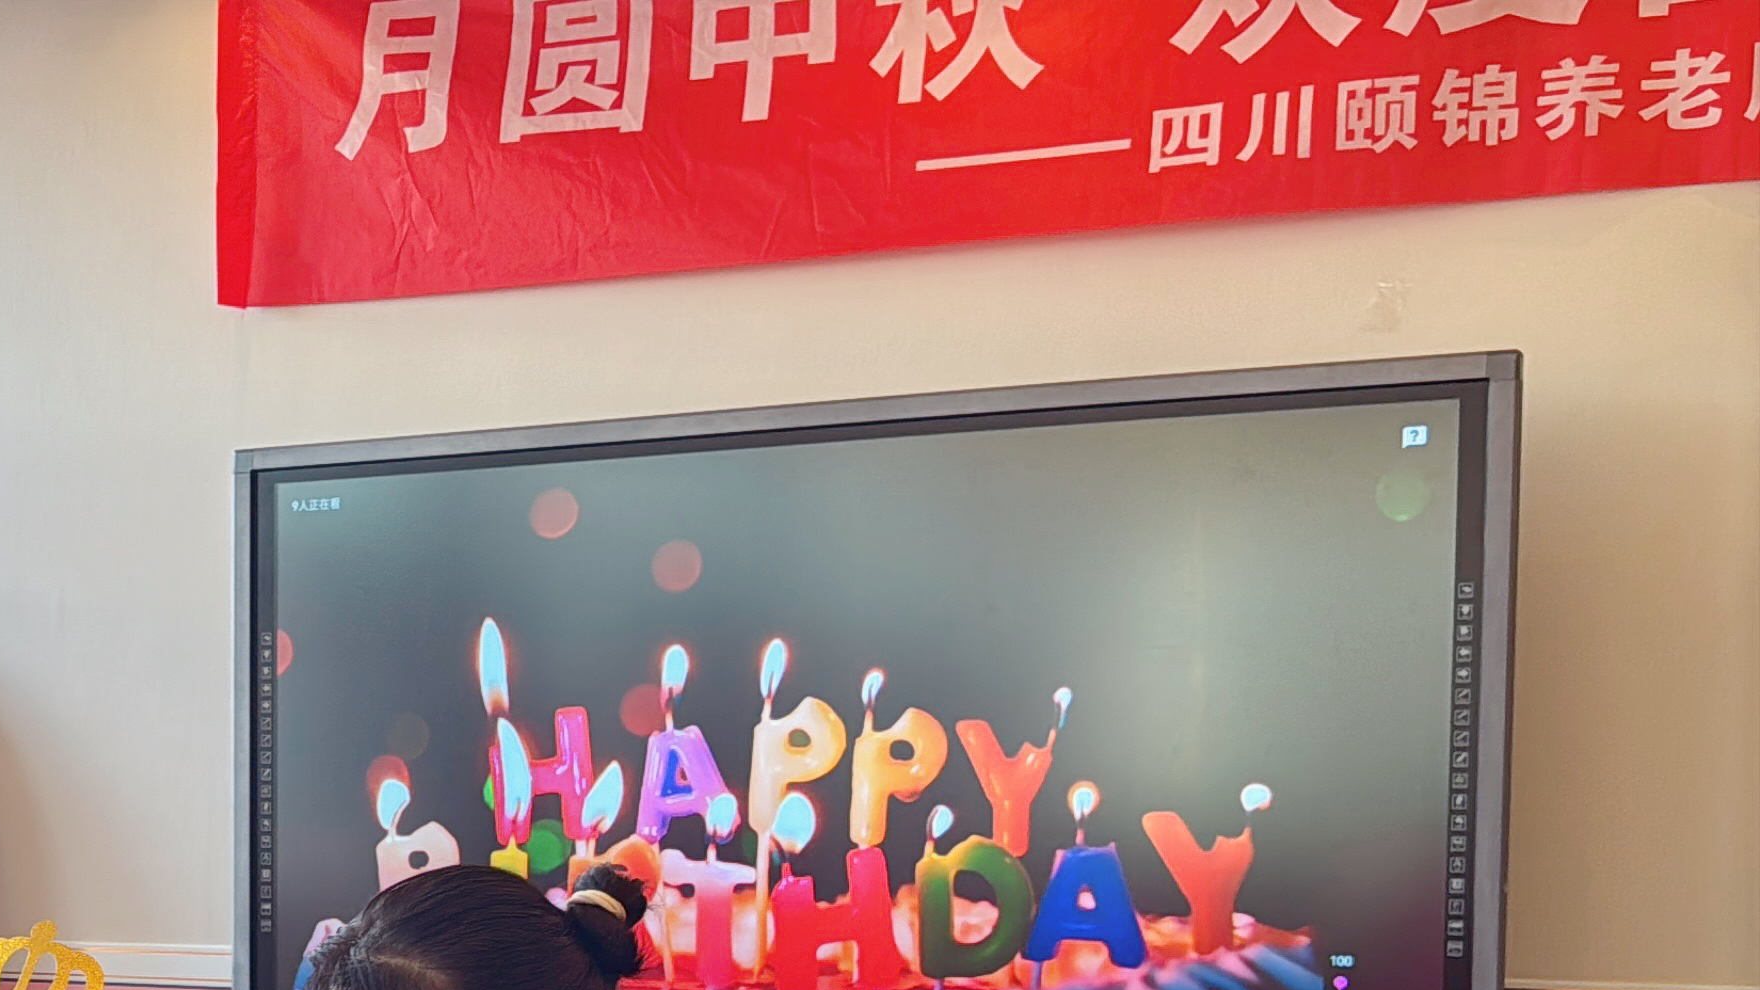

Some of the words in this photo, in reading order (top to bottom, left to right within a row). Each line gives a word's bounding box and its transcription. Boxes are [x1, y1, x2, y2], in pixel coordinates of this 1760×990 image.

[334, 0, 1044, 160] 月圆中秋
[1148, 45, 1760, 174] 四川颐锦养老
[488, 696, 1053, 858] HAPPY
[1330, 954, 1355, 968] 100
